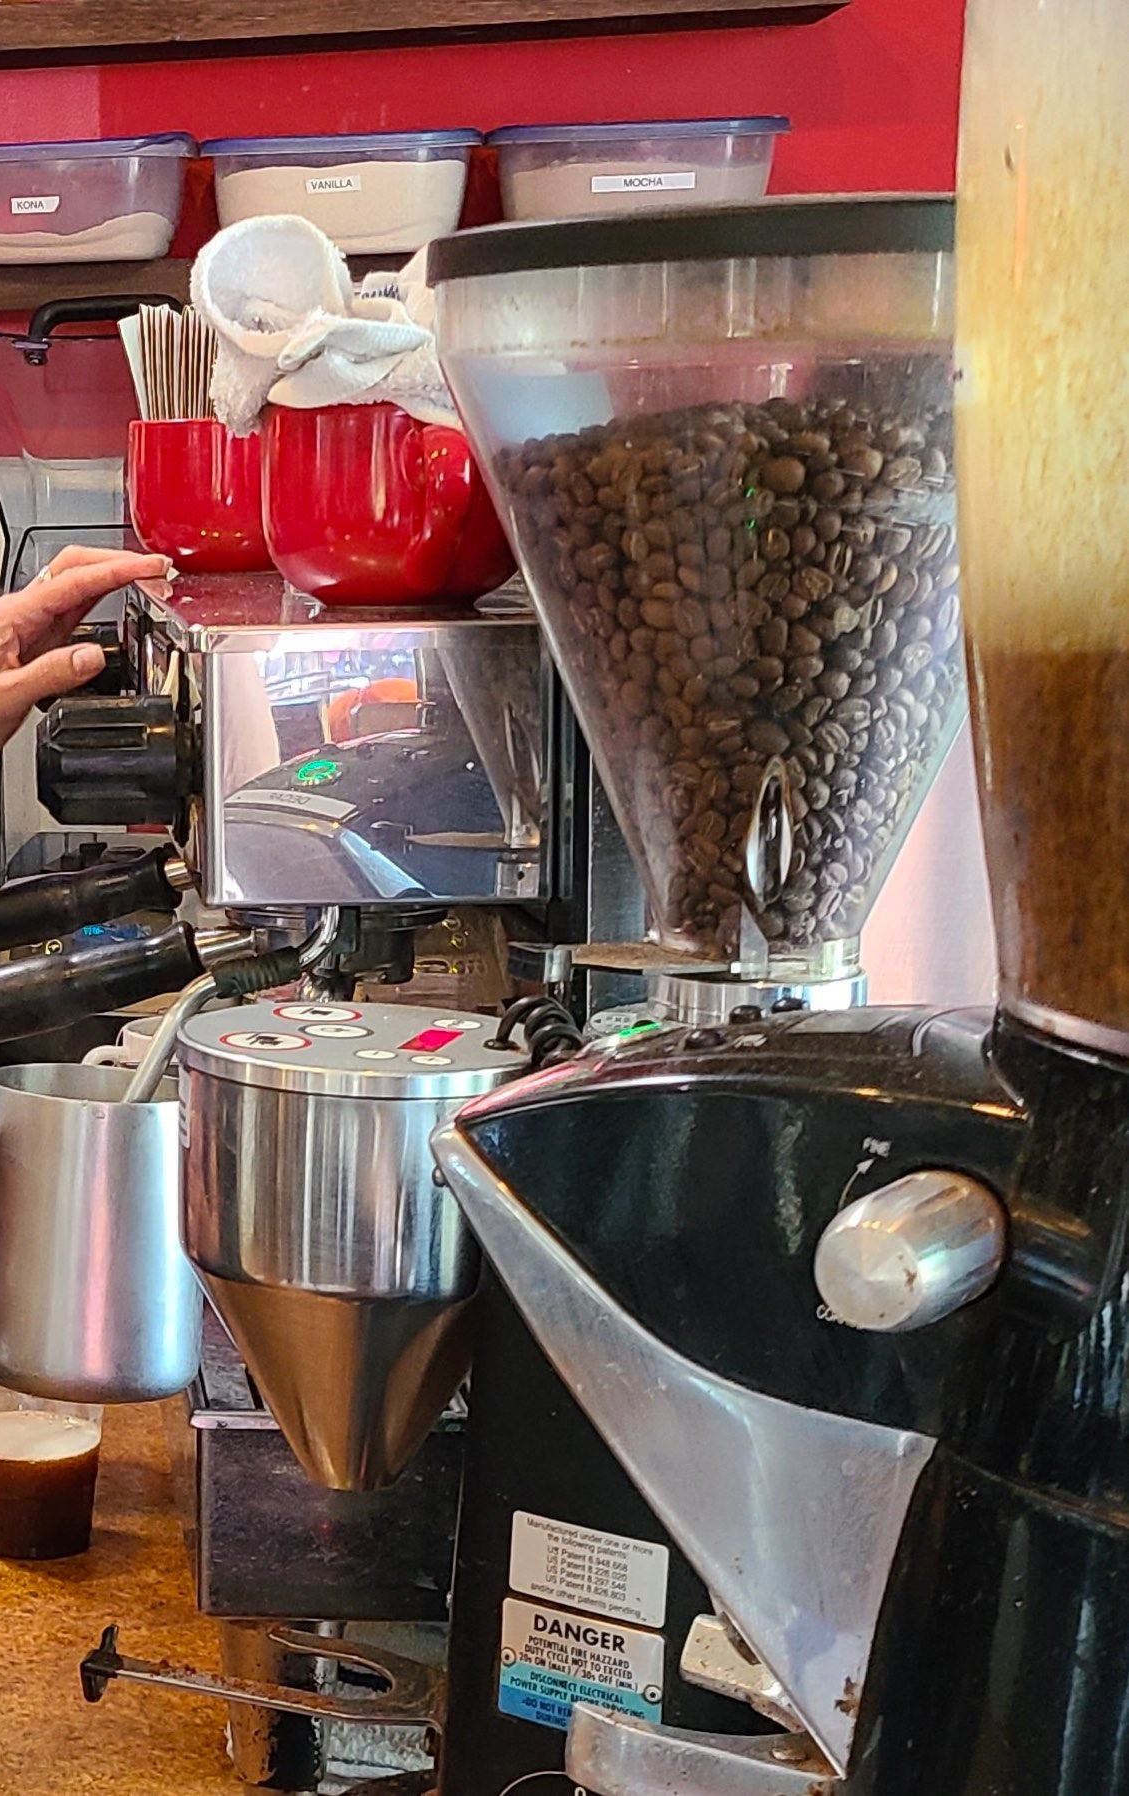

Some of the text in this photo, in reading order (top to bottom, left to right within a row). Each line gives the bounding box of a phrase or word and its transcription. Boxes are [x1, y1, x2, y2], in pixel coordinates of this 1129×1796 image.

[311, 178, 353, 190] VANILLA
[623, 177, 664, 187] MOCHA
[16, 200, 45, 210] KONA
[546, 1555, 558, 1565] US
[560, 1558, 585, 1571] Patent
[561, 1548, 586, 1562] Patent
[546, 1565, 558, 1575] US
[560, 1568, 585, 1581] Patent
[545, 1574, 557, 1584] US
[559, 1577, 584, 1591] Patent
[534, 1614, 625, 1653] DANGER
[529, 1635, 630, 1669] POTENTIAL FIRE HAZZARD
[525, 1645, 633, 1680] DUTY CYCLE NOT TO EXCEED
[534, 1656, 546, 1667] ON
[598, 1673, 613, 1686] OFF
[510, 1676, 538, 1692] POWER
[540, 1685, 568, 1700] SUPPLY
[530, 1671, 624, 1705] DISCONNECT ELECTRICAL
[539, 1700, 556, 1713] NOT
[535, 1711, 567, 1727] DURING
